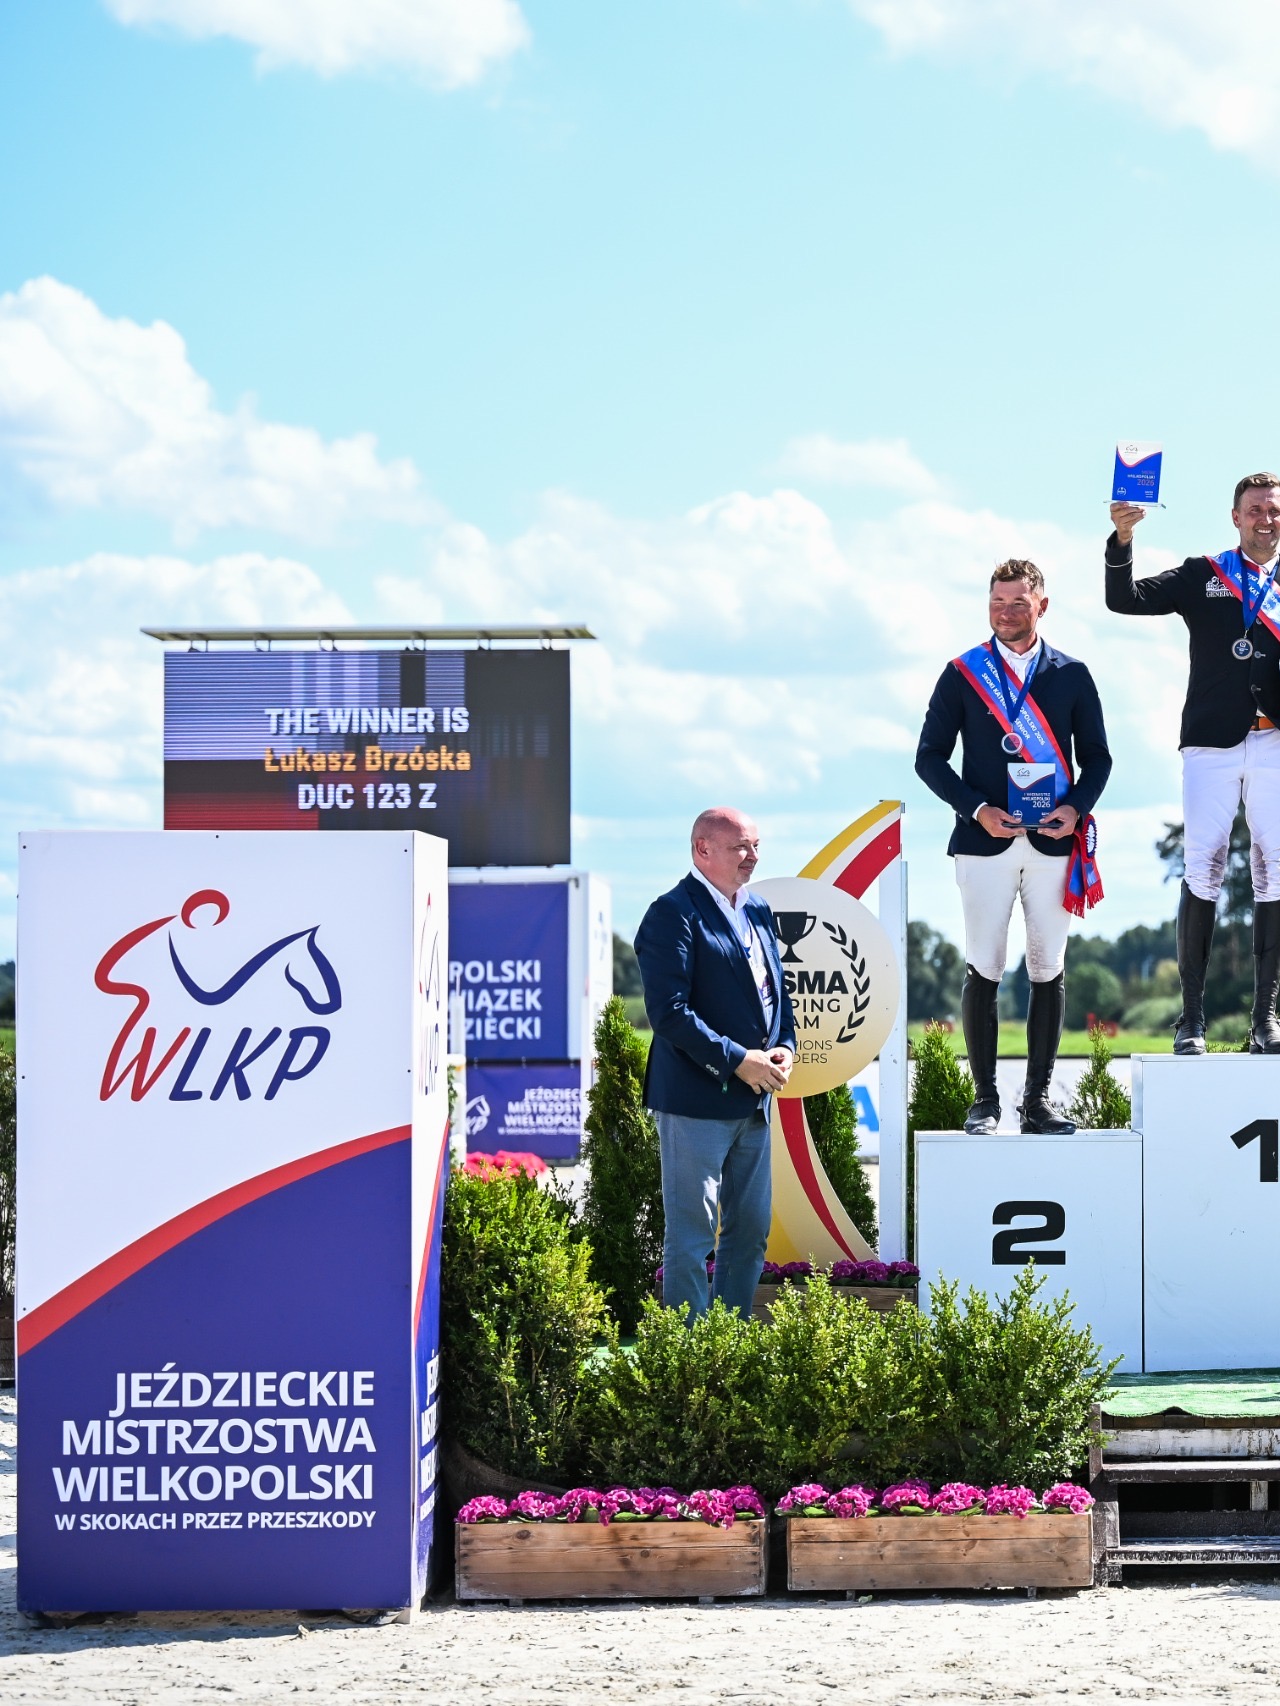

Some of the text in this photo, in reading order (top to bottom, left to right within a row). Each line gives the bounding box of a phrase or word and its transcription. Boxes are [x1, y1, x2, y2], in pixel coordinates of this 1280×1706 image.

[264, 707, 469, 735] THE WINNER IS
[264, 745, 472, 771] Łukasz Brzóska
[298, 783, 437, 809] DUC 123 Z
[448, 960, 541, 983] POLSKI
[783, 971, 849, 995] SMA
[791, 998, 841, 1013] PING
[449, 1016, 541, 1041] ZIECKI
[99, 1025, 331, 1101] WLKP
[1230, 1119, 1279, 1183] 1
[992, 1200, 1066, 1265] 2
[109, 1362, 375, 1417] JEŹDZIECKIE
[62, 1417, 376, 1456] MISTRZOSTWA
[52, 1464, 374, 1502] WIELKOPOLSKI
[55, 1510, 376, 1531] W SKOKACH PRZEZ PRZESZKODY
